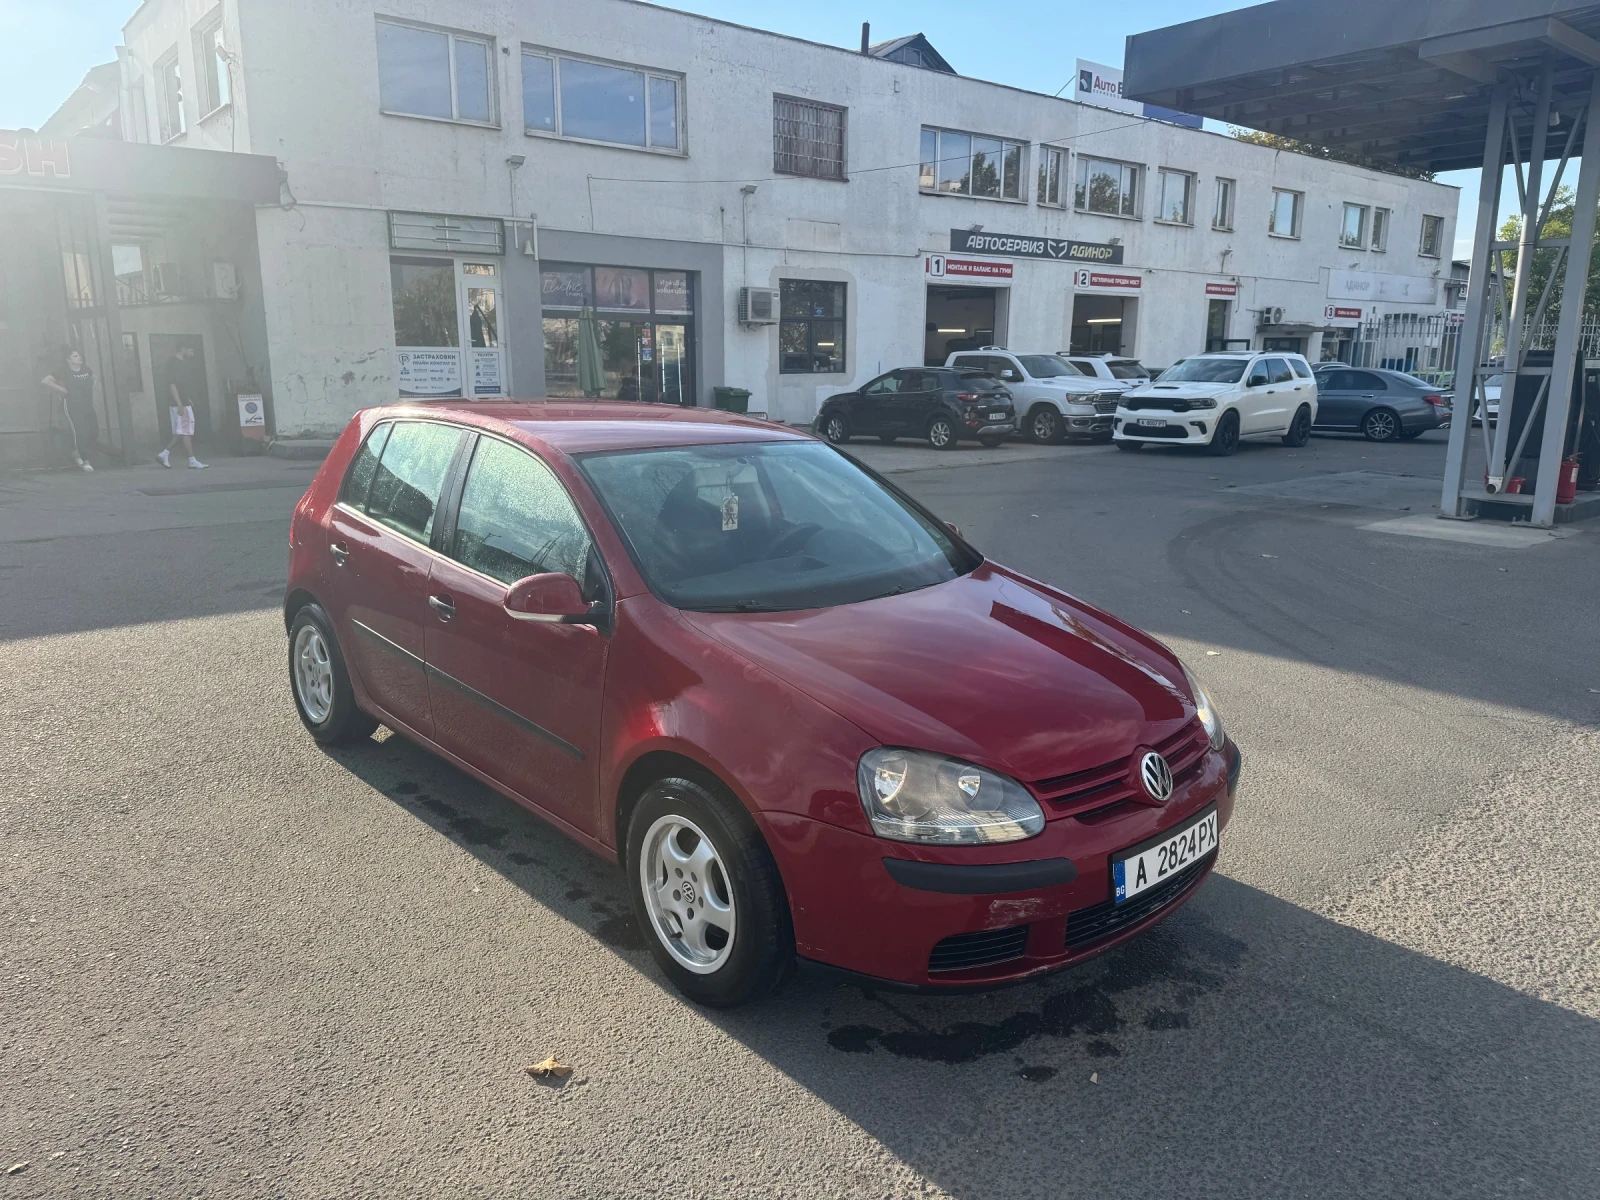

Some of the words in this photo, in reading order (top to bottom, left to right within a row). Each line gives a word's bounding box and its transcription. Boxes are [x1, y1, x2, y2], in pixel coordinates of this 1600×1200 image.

[966, 235, 1044, 254] АВТОСЕРВИЗ
[1069, 244, 1113, 260] АДИНОР
[1080, 272, 1087, 285] 2
[1329, 307, 1333, 317] 3
[1135, 856, 1148, 889] A
[1115, 884, 1125, 897] BG
